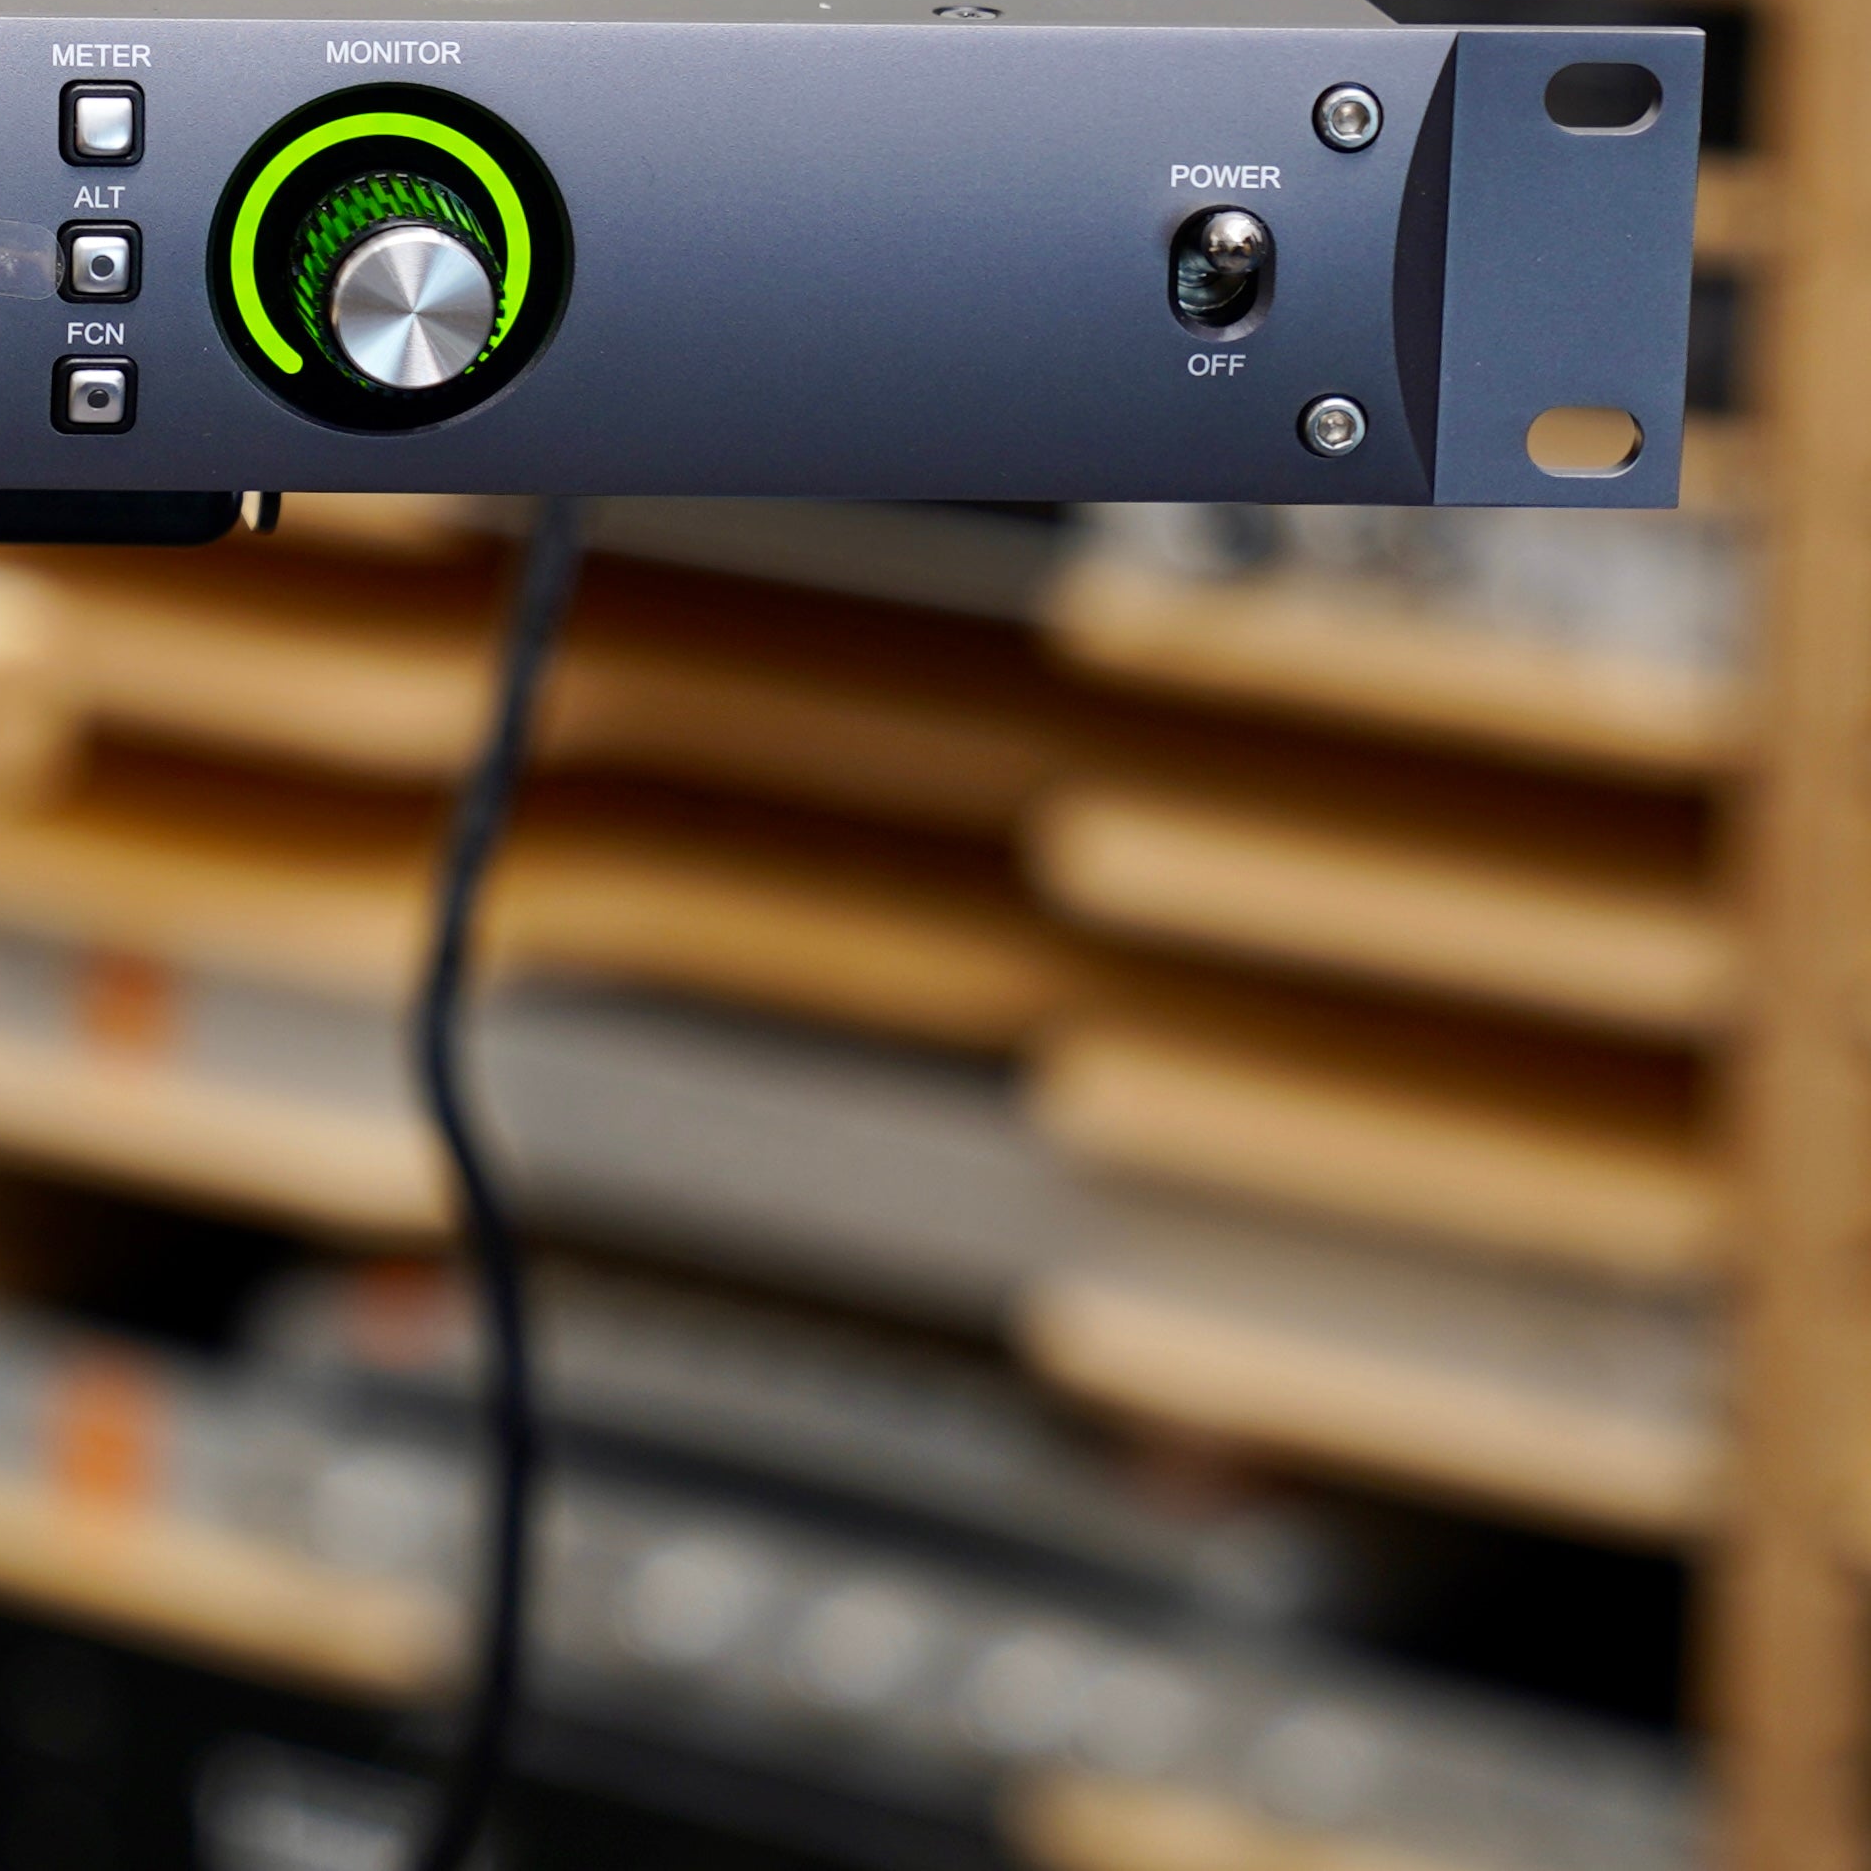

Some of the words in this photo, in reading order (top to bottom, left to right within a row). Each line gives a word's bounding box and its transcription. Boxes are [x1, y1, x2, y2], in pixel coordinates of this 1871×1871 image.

[52, 43, 152, 68] METER
[326, 40, 462, 65] MONITOR
[1170, 164, 1281, 189] POWER
[73, 185, 126, 209] ALT
[67, 322, 125, 345] FCN
[1187, 353, 1246, 377] OFF
